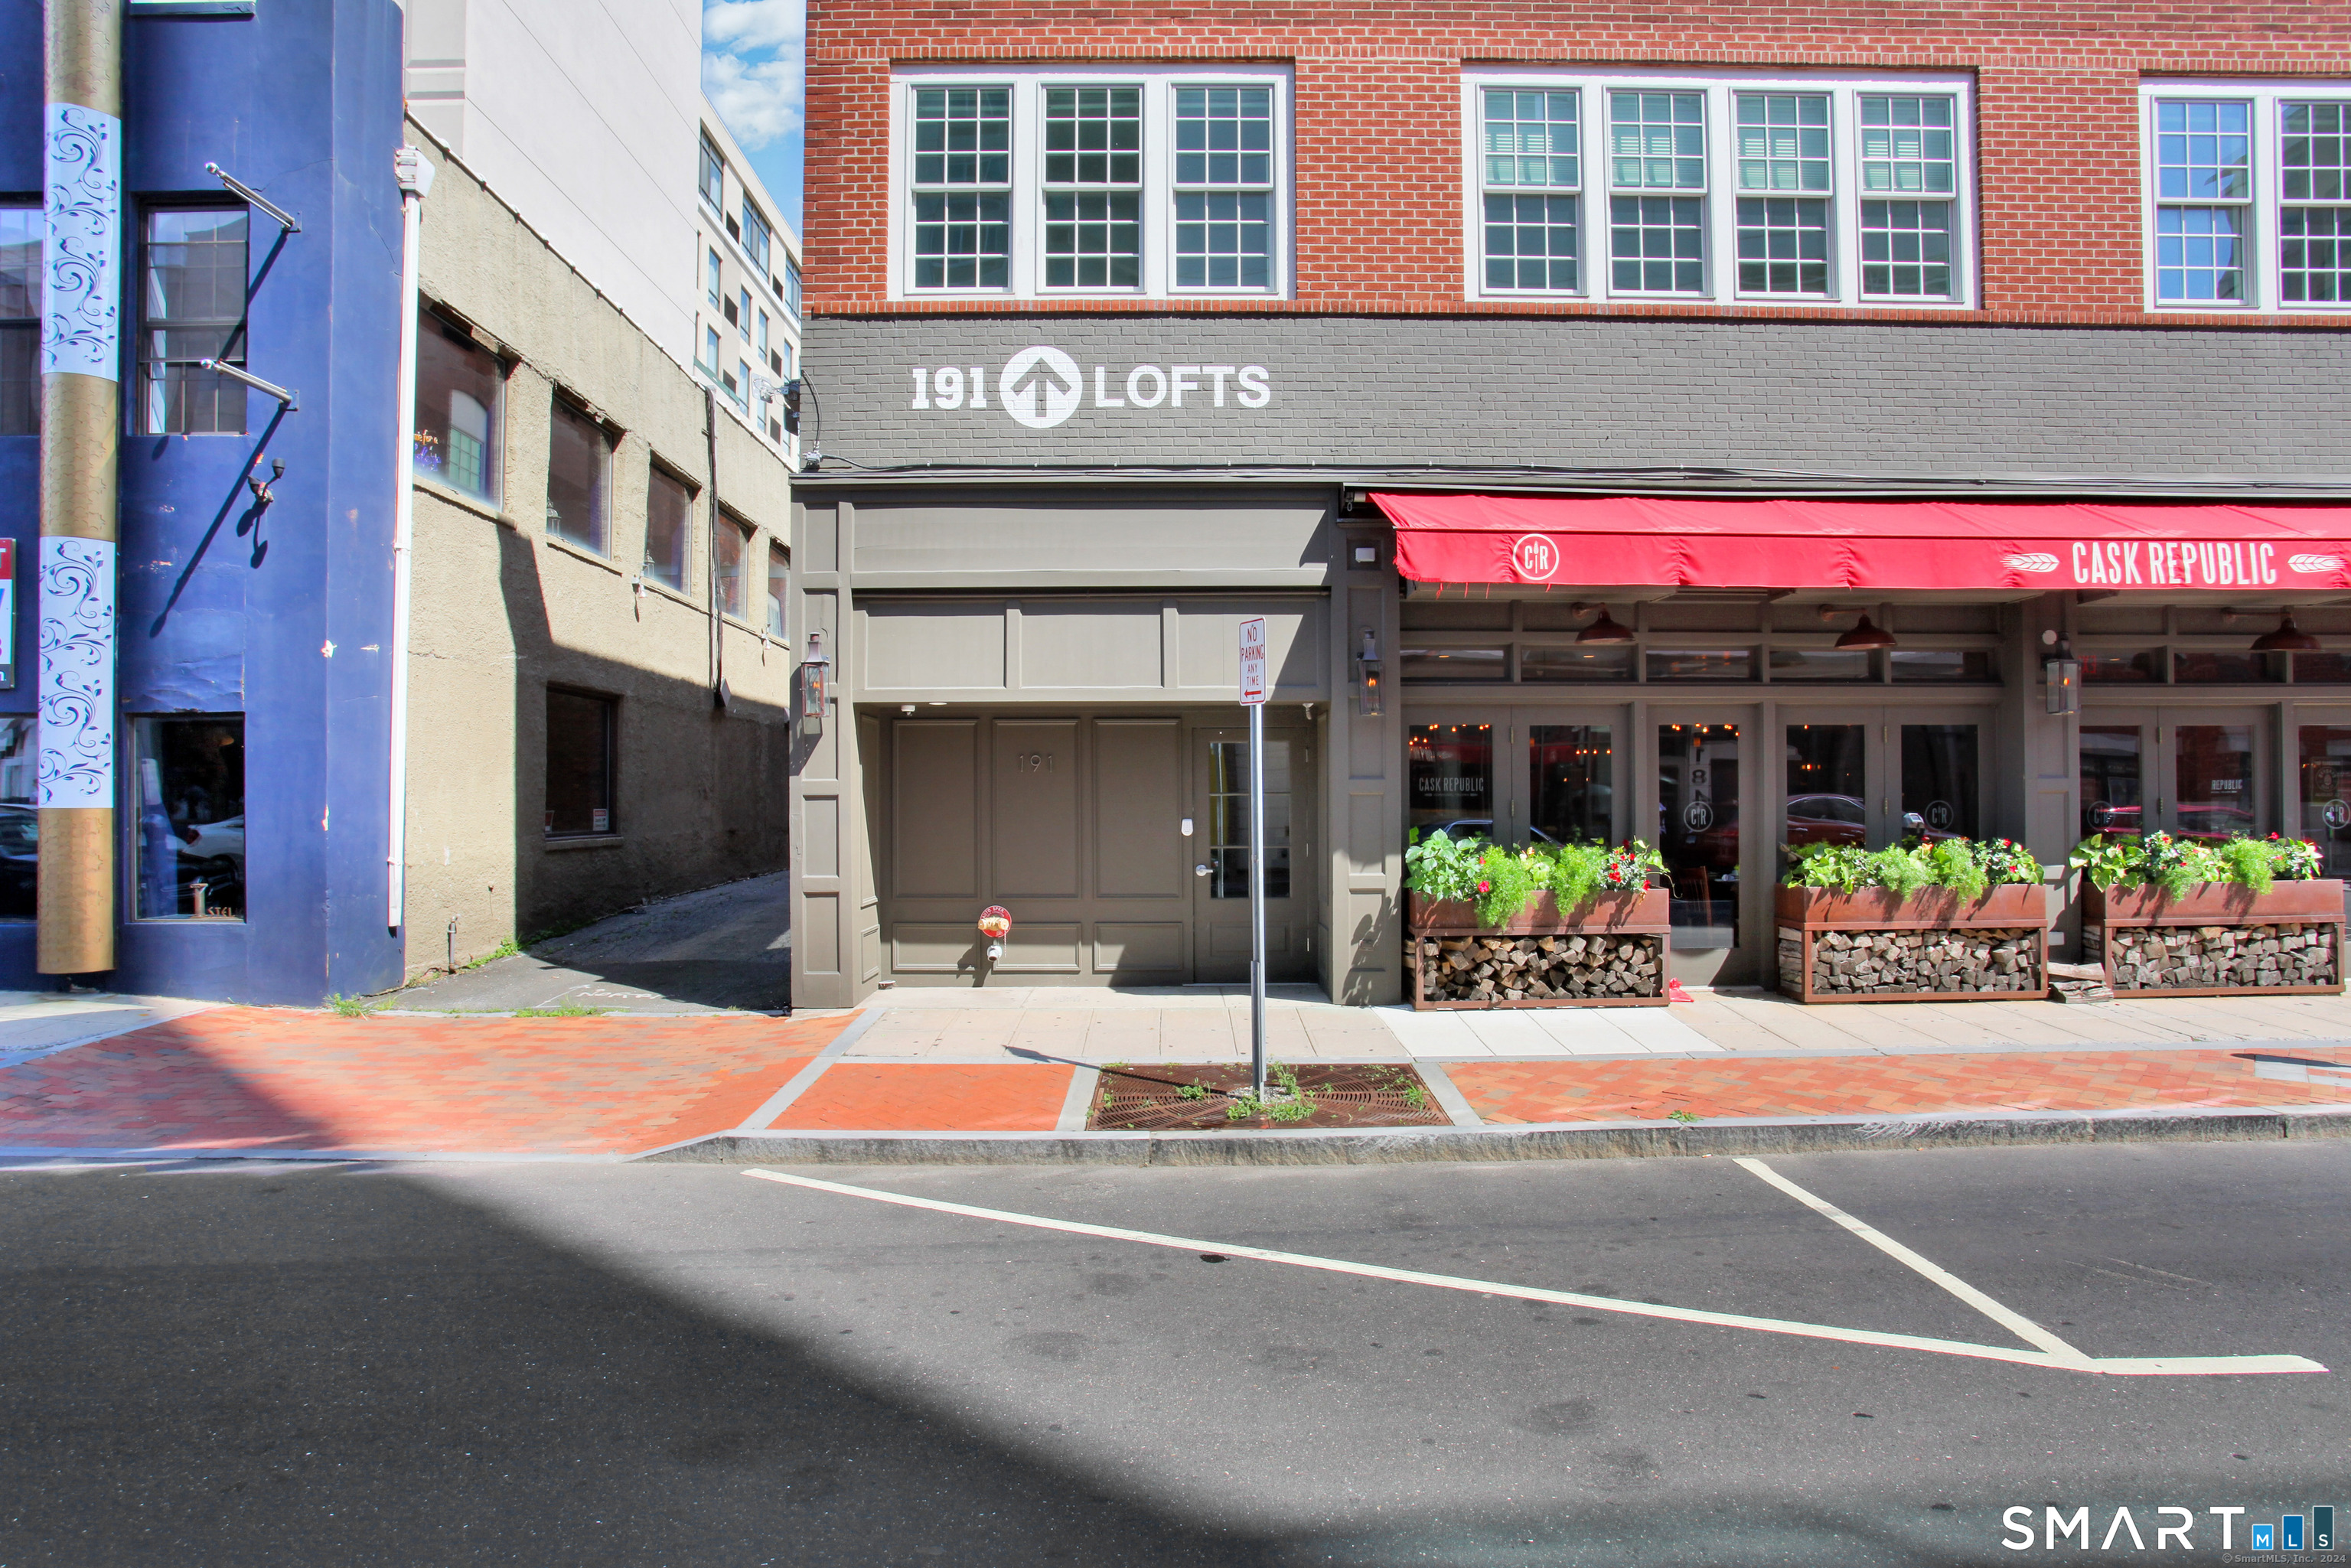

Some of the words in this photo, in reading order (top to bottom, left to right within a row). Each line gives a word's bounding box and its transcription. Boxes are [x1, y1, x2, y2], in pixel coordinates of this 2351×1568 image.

[911, 367, 987, 410] 191
[1094, 363, 1271, 409] LOFTS
[2072, 542, 2143, 585] CASK
[2149, 542, 2277, 585] REPUBLIC
[1247, 627, 1257, 644] NO
[1241, 644, 1264, 663] PARKING
[1247, 663, 1258, 674] ANY
[1246, 675, 1260, 687] TIME
[1019, 755, 1052, 773] 191
[1419, 777, 1441, 792] CASK
[1443, 777, 1484, 792] REPUBLIC
[2211, 779, 2243, 791] REPUBLIC
